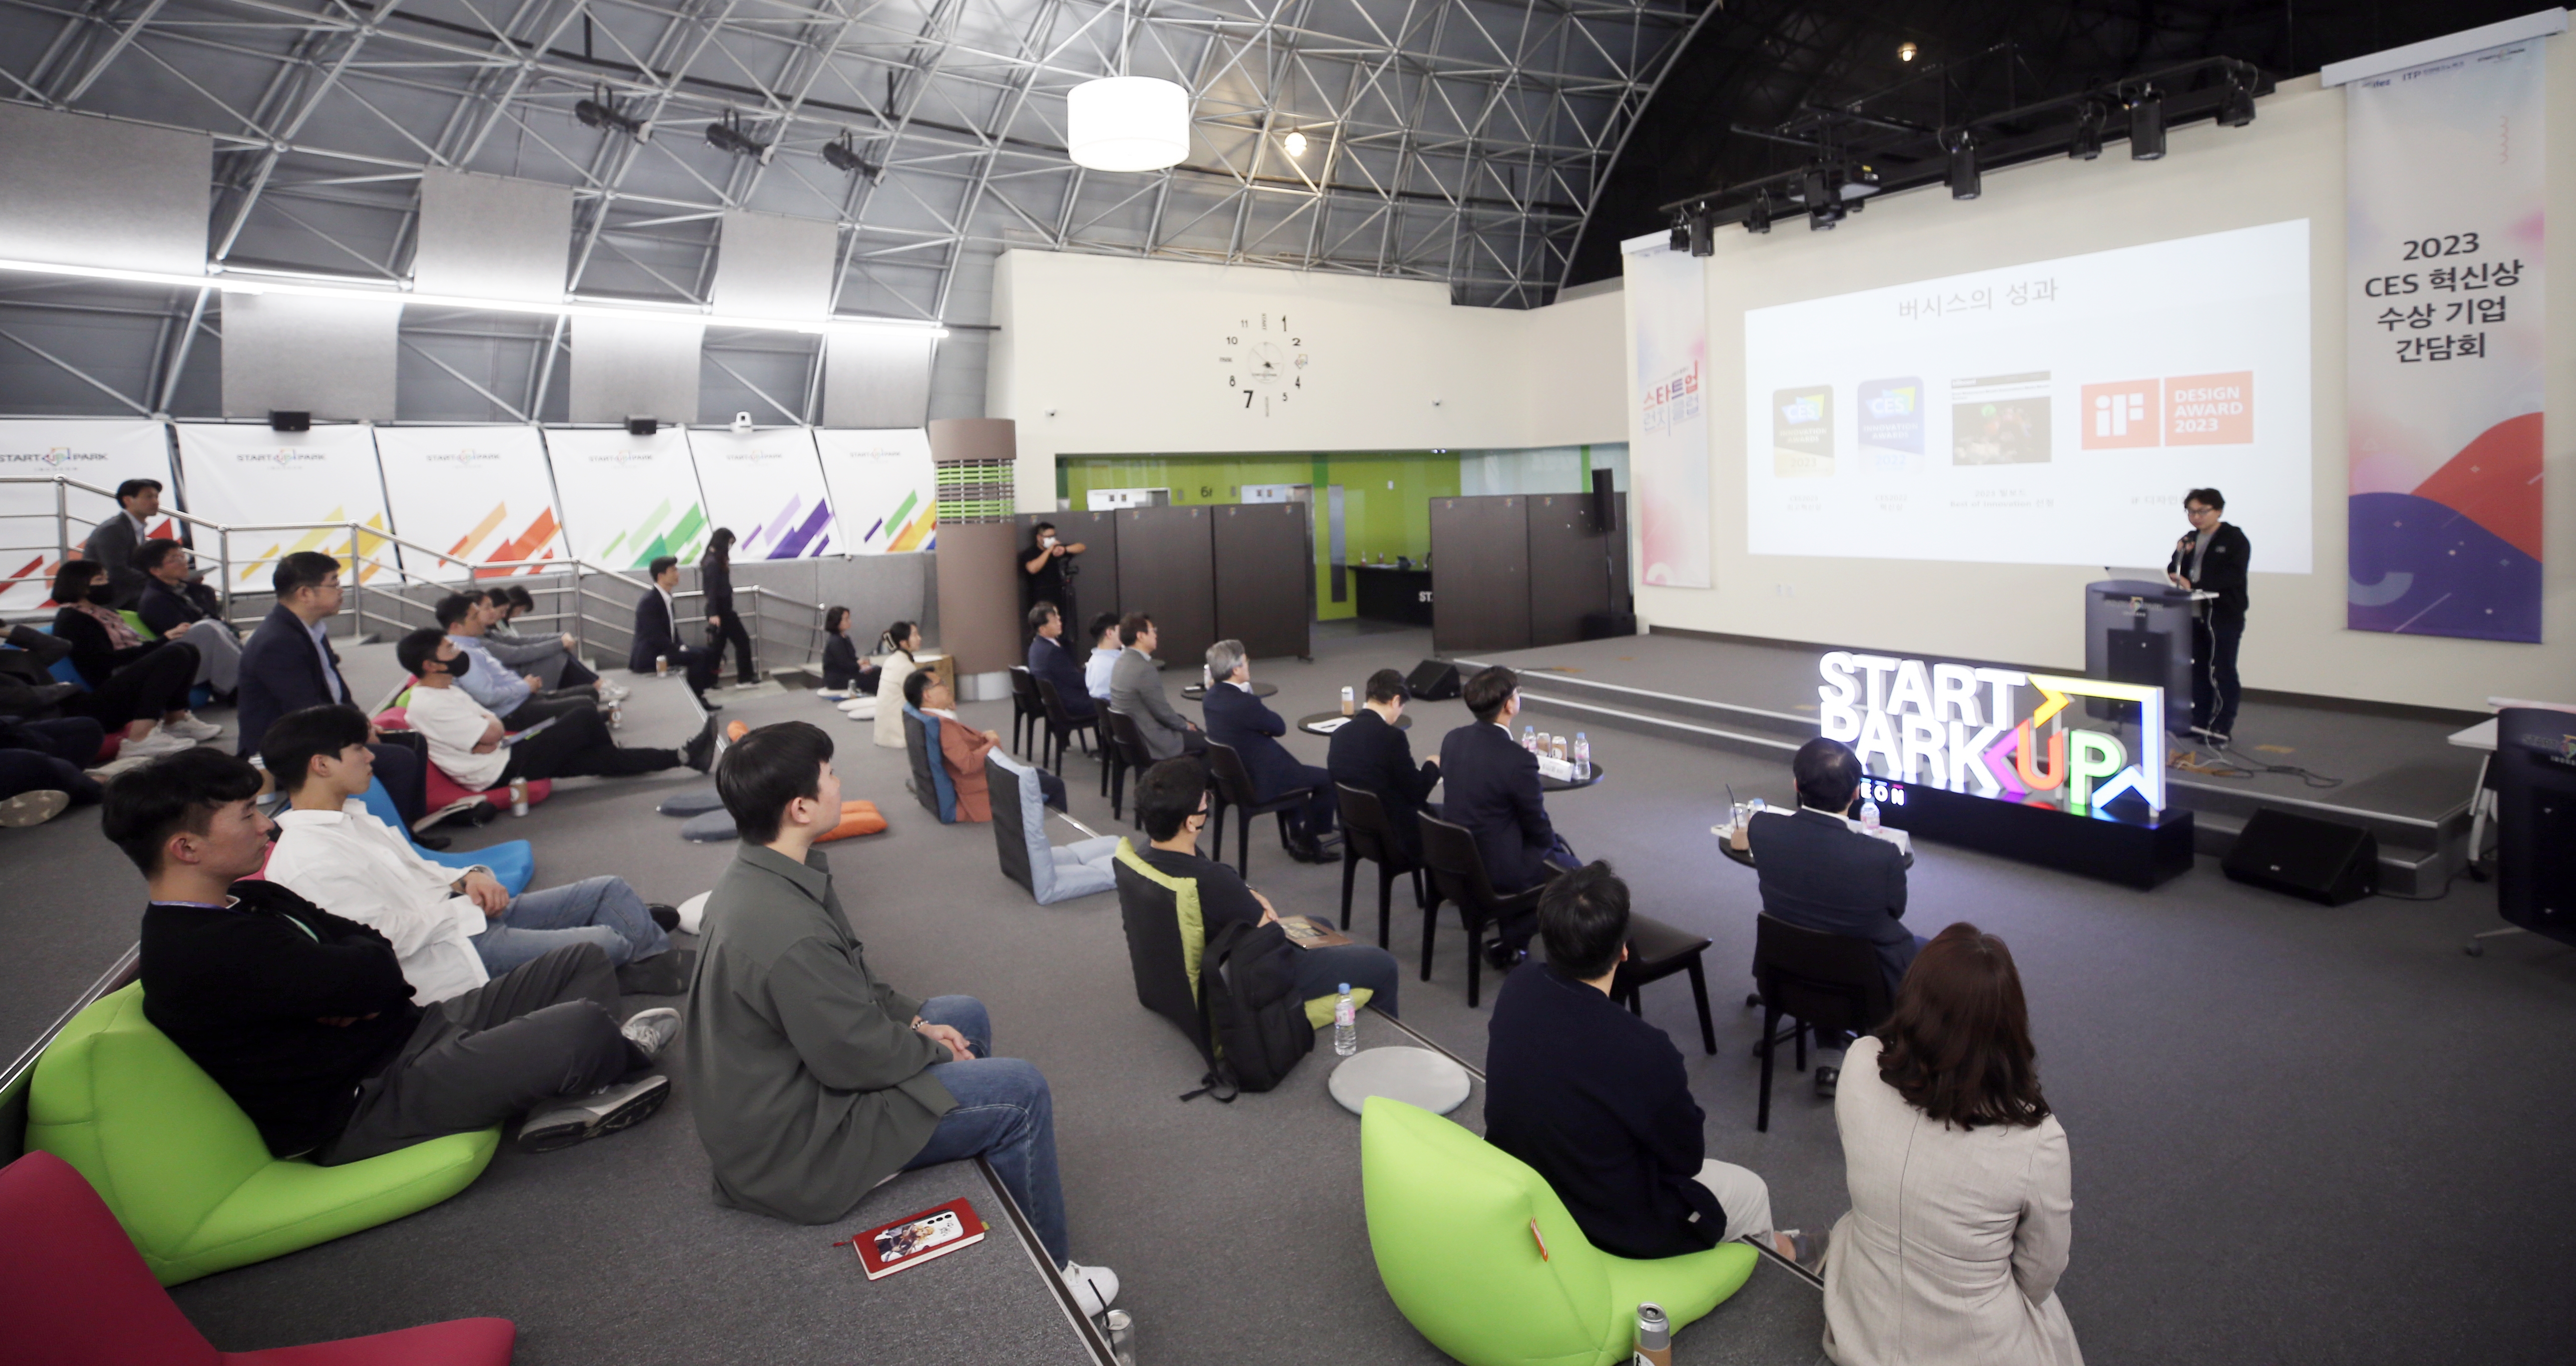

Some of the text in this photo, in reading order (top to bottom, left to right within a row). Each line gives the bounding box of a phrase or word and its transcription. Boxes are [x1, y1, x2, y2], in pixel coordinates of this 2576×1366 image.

[2403, 232, 2480, 261] 2023
[2365, 259, 2524, 297] CES 혁신상
[1900, 277, 2059, 321] 버시스의 성과
[2377, 296, 2506, 332] 수상 기업
[1241, 320, 1249, 328] 11
[1282, 315, 1287, 332] 1
[1226, 336, 1238, 345] 10
[1291, 338, 1301, 346] 2
[2396, 332, 2485, 363] 간담회
[1230, 375, 1236, 387] 8
[1295, 375, 1301, 389] 4
[1643, 360, 1697, 411] 스타트업
[1243, 389, 1254, 409] 7
[1283, 392, 1288, 401] 5
[2174, 386, 2240, 403] DESIGN
[1788, 403, 1816, 418] CES
[1872, 396, 1905, 413] CES
[2174, 401, 2244, 417] AWARD
[1779, 427, 1827, 436] INNOVATION
[1863, 422, 1918, 432] INNOVATION
[2174, 417, 2219, 433] 2023
[1873, 431, 1909, 440] AWARDS
[237, 453, 272, 462] START
[298, 453, 325, 461] PARK
[1790, 456, 1817, 468] 2023
[1875, 454, 1906, 466] 2022
[1818, 651, 2028, 730] START
[1820, 700, 2125, 806] PARK UP
